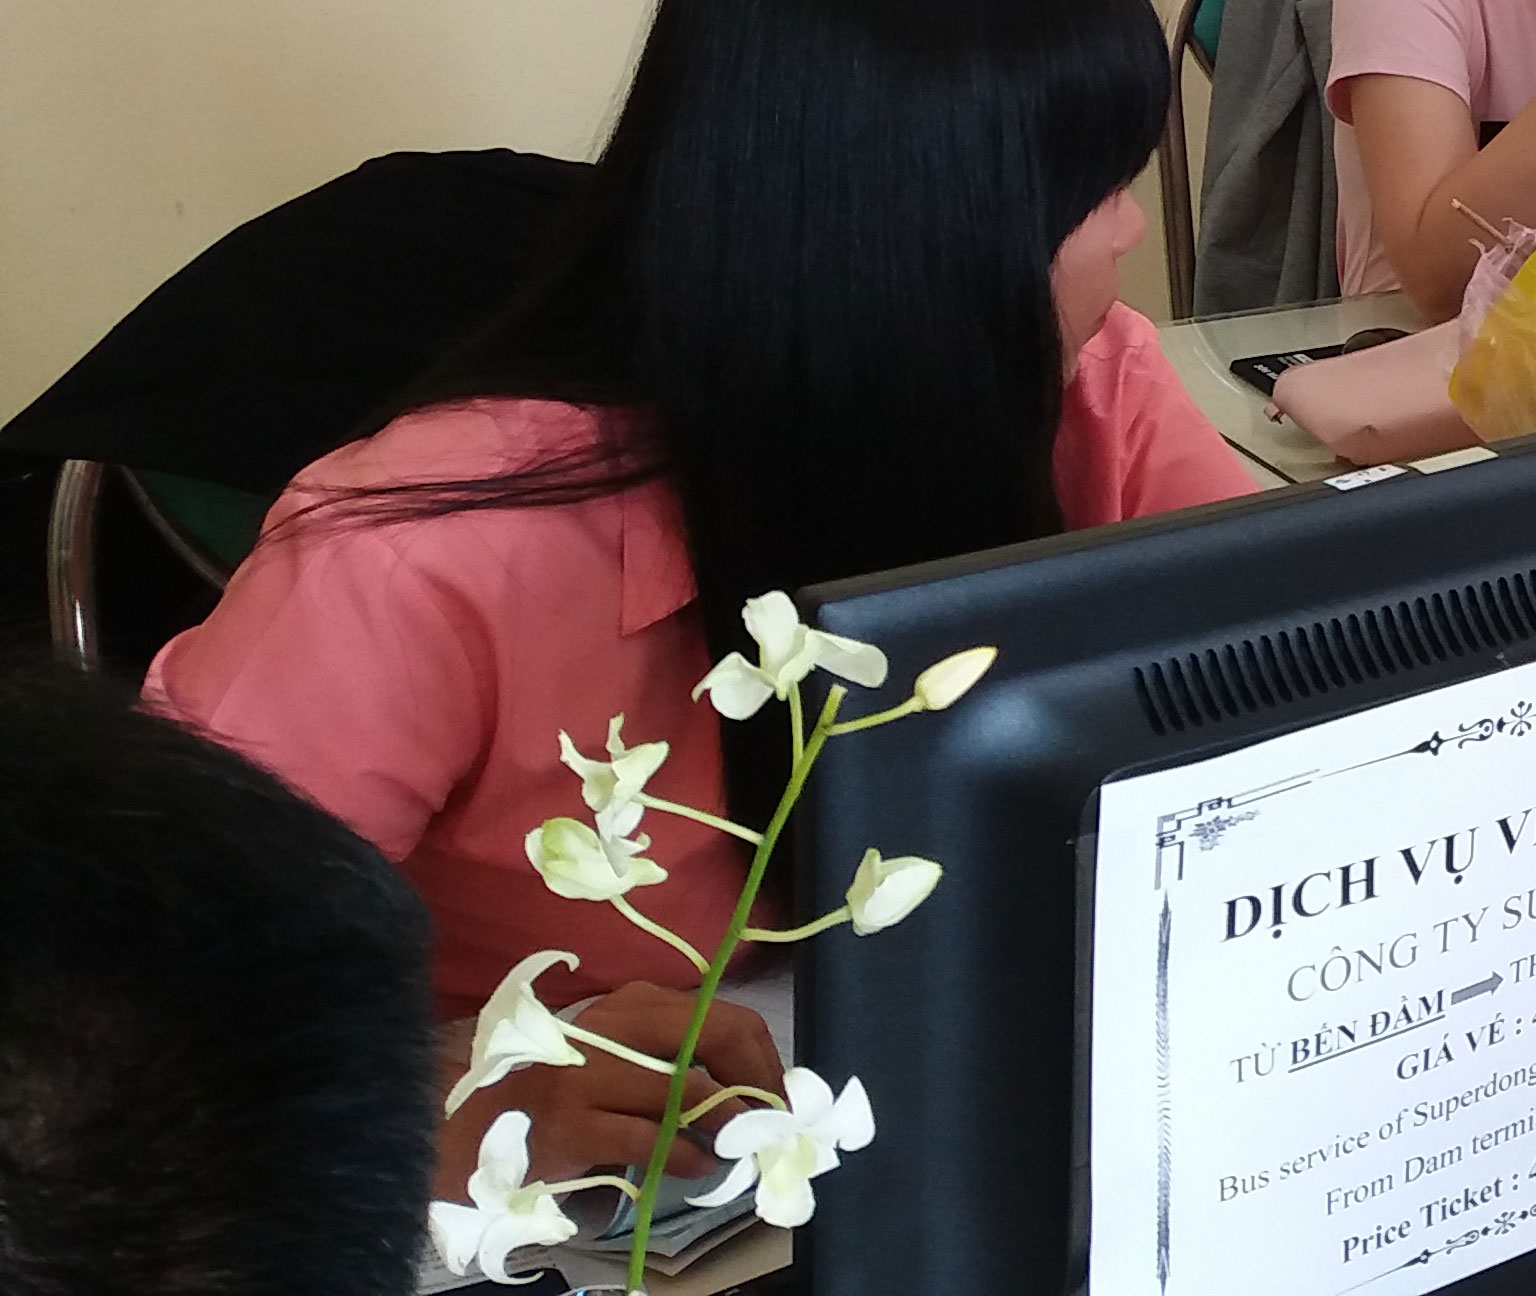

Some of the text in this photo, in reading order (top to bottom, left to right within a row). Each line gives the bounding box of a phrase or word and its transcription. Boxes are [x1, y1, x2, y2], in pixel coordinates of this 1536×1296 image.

[1220, 855, 1380, 942] DỊCH
[1397, 826, 1480, 886] VỤ
[1286, 932, 1419, 1002] CÔNG
[1432, 906, 1490, 954] TY
[1229, 1042, 1282, 1084] TỪ
[1288, 1020, 1358, 1067] BẾN
[1396, 1032, 1456, 1081] GIÁ
[1464, 1011, 1507, 1053] VÉ
[1219, 1170, 1271, 1203] Bus
[1278, 1130, 1371, 1181] service
[1378, 1108, 1409, 1141] of
[1325, 1173, 1394, 1216] From
[1403, 1145, 1463, 1185] Dam
[1341, 1219, 1412, 1265] Price
[1419, 1175, 1504, 1230] Ticket
